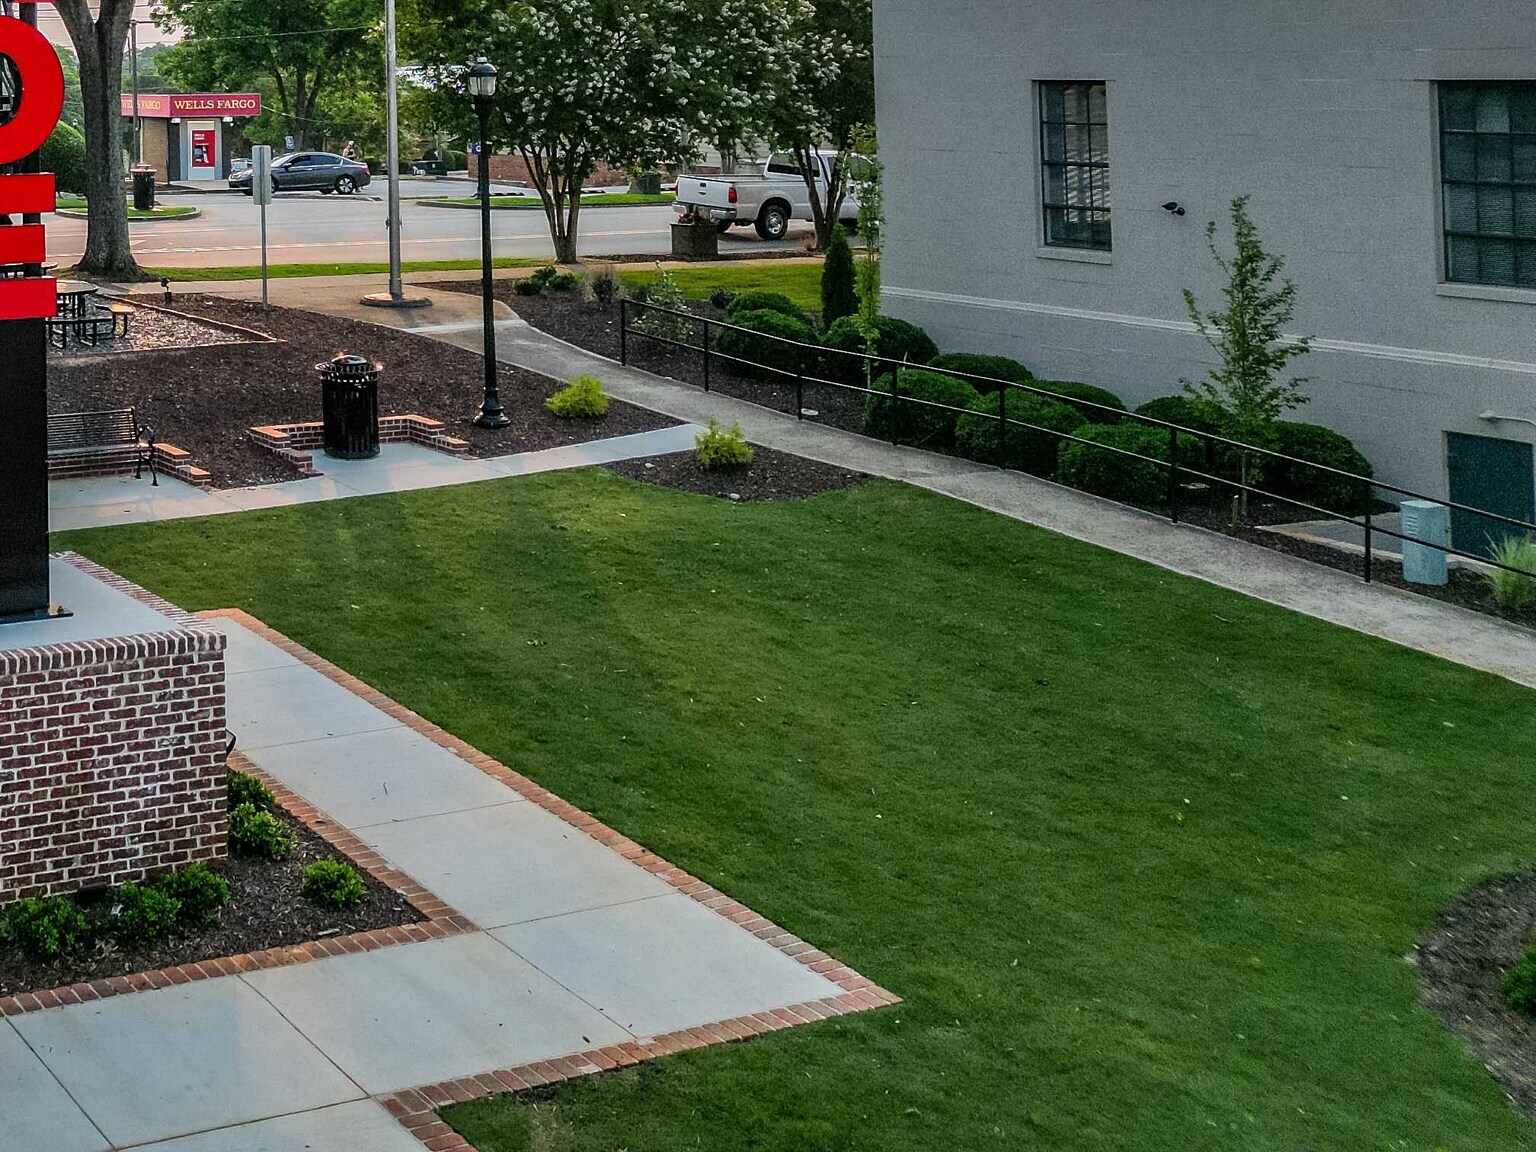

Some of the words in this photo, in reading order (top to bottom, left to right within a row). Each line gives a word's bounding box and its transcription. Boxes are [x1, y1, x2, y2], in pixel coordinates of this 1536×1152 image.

[122, 99, 140, 110] WELS
[174, 99, 215, 110] WELLS
[216, 99, 257, 109] FARGO
